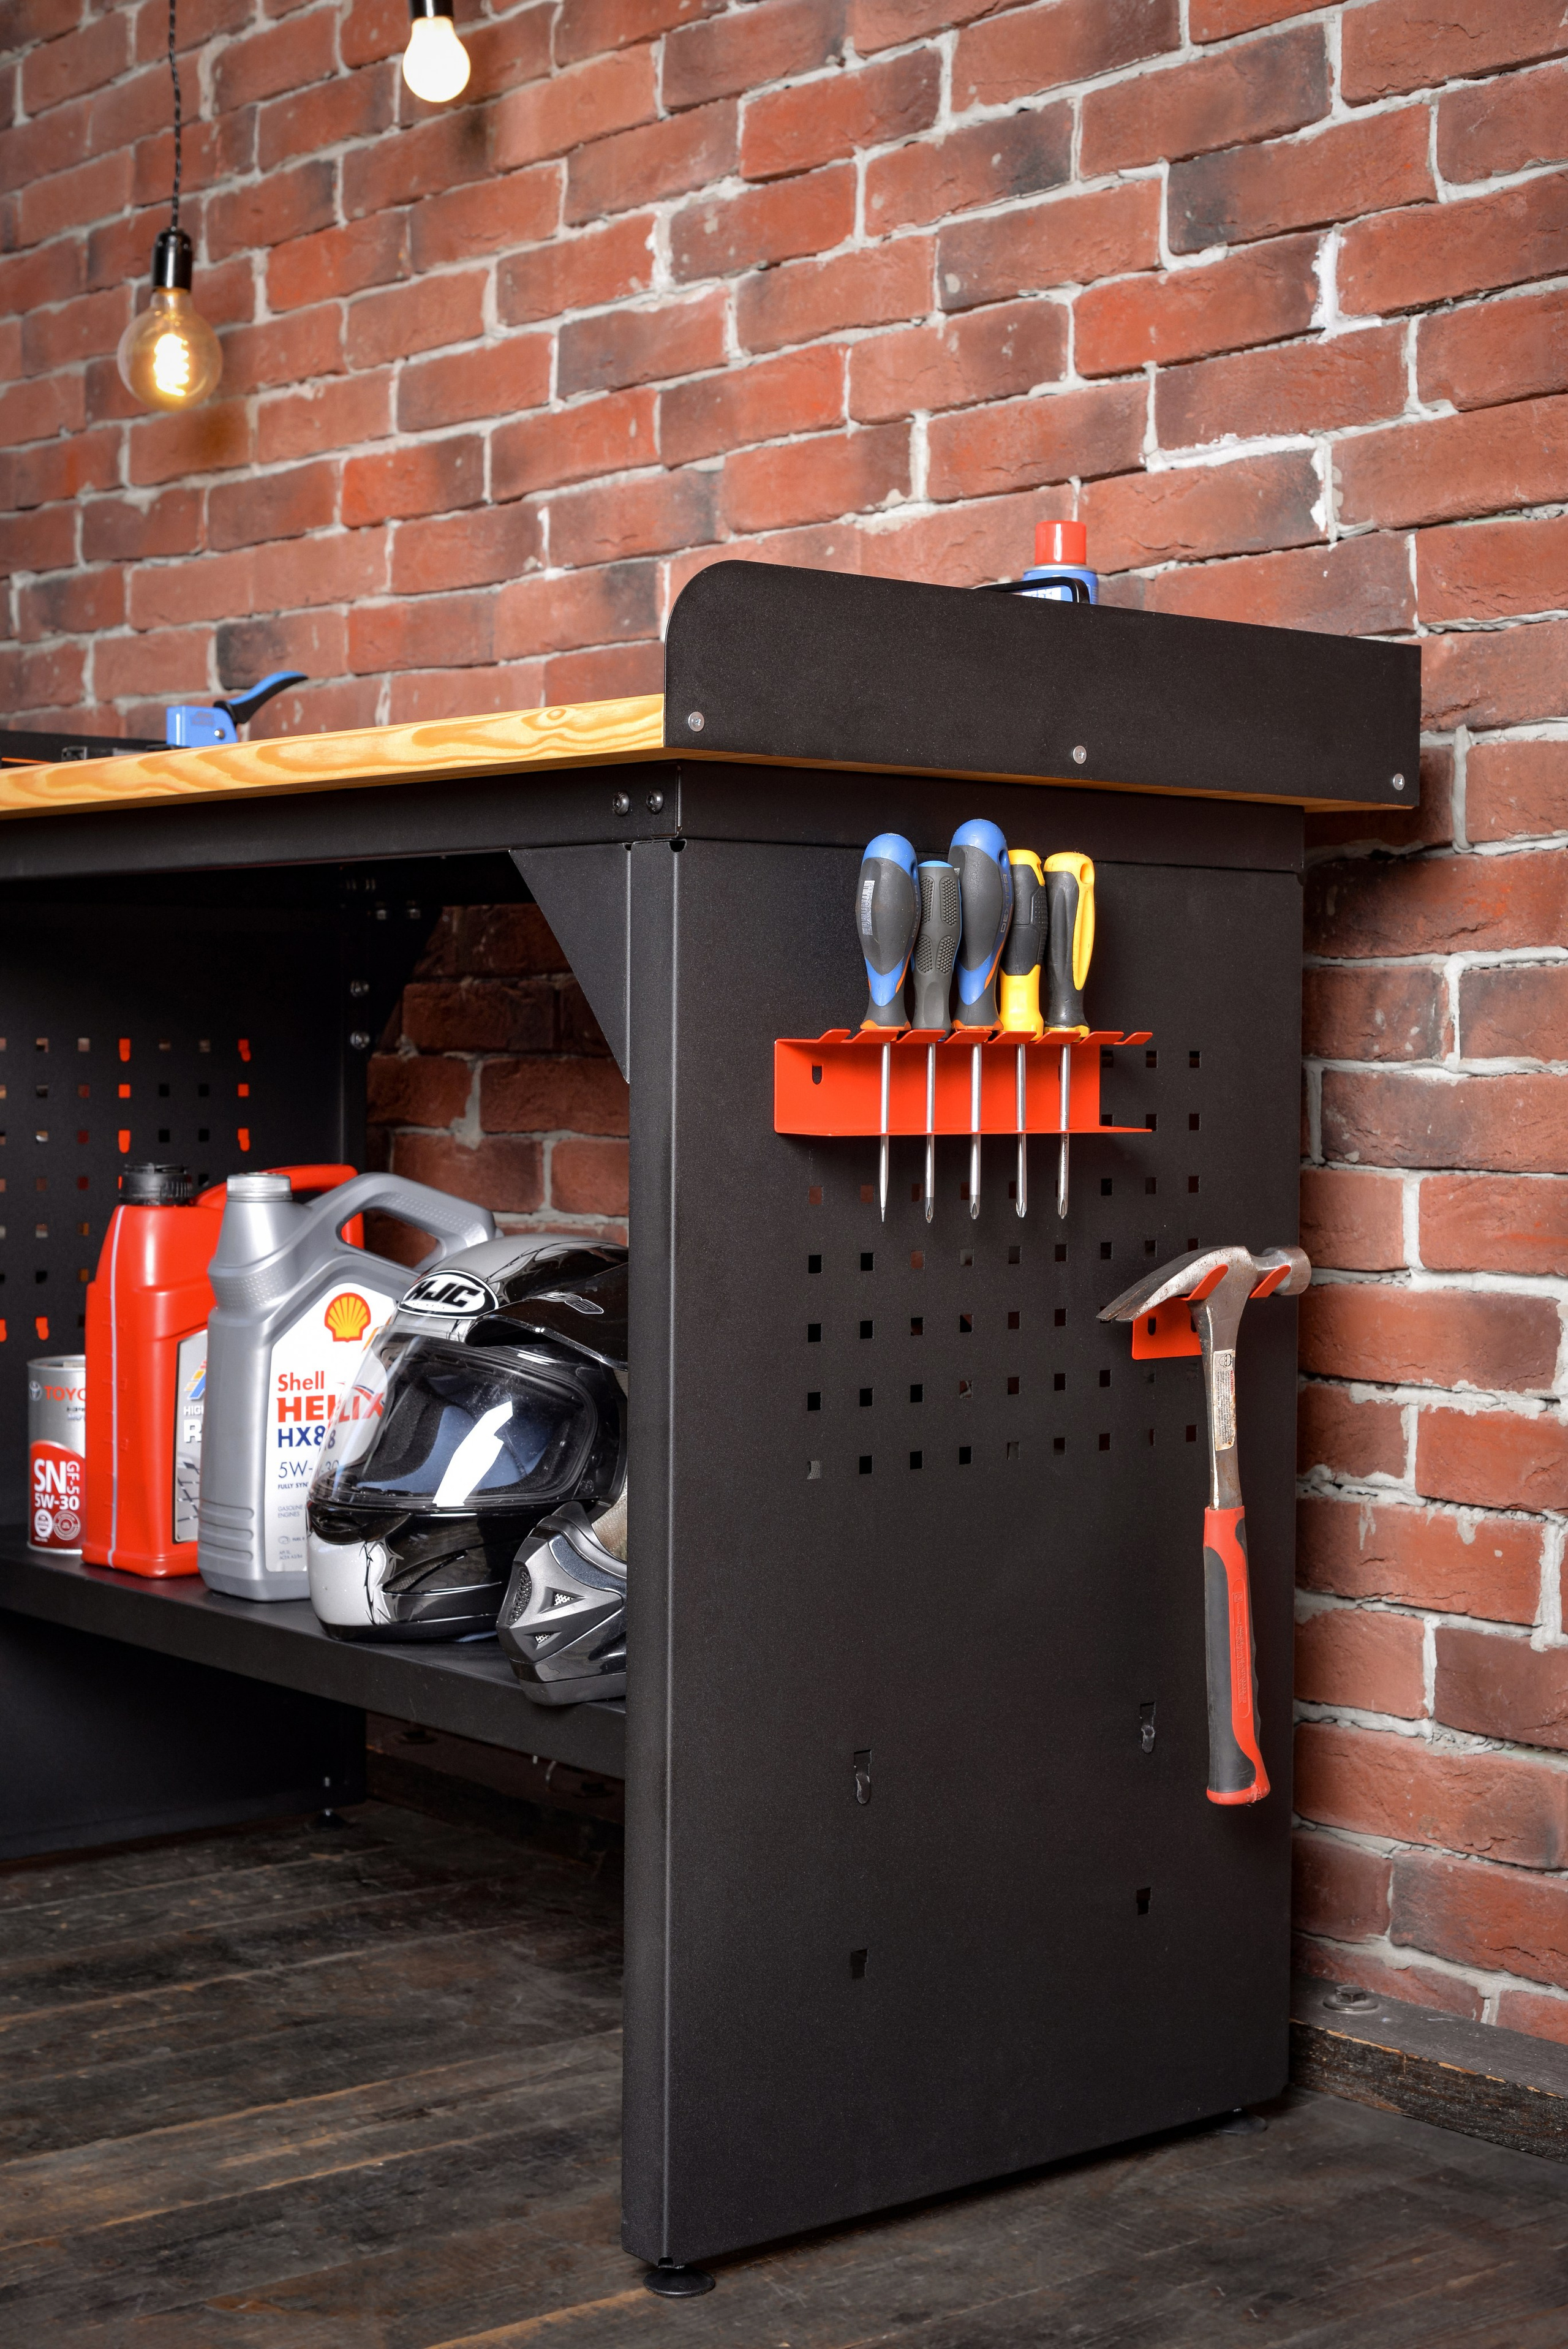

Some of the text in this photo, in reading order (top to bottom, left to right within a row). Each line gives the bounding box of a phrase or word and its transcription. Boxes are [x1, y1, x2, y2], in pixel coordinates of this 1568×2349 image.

[1000, 873, 1009, 933] DEXTER
[404, 1279, 481, 1308] HJC
[277, 1371, 324, 1392] Shell
[34, 1458, 67, 1494] SN
[67, 1461, 80, 1495] GF-5
[34, 1493, 80, 1510] 5W-30
